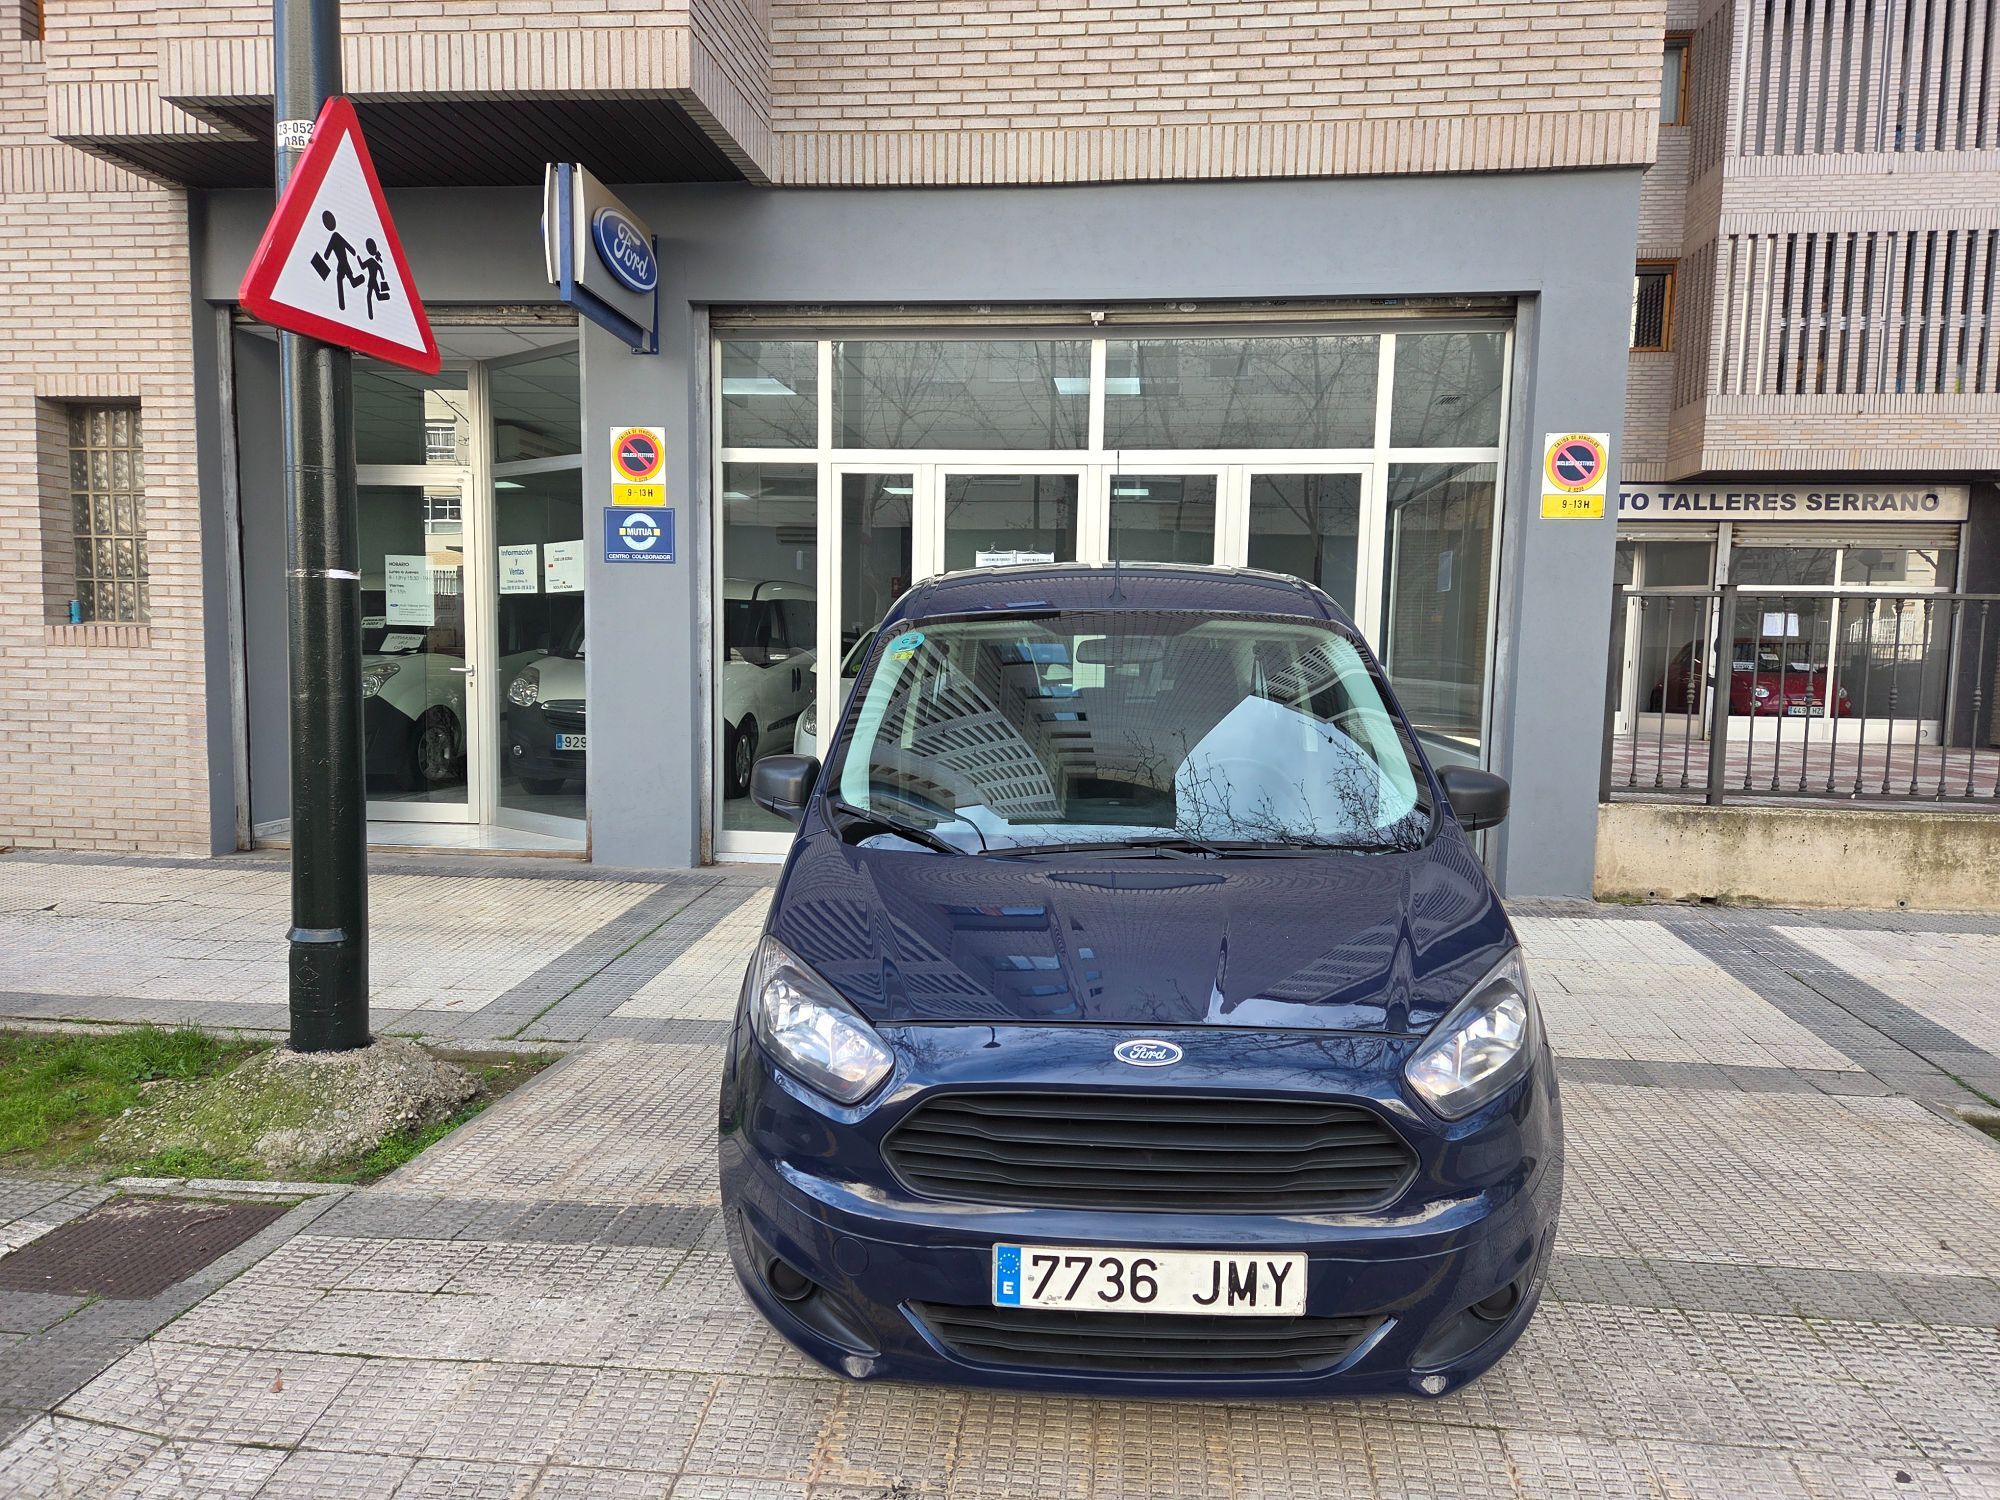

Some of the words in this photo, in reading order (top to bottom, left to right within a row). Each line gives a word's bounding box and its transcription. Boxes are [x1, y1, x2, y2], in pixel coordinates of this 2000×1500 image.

[614, 223, 649, 280] Ford
[1618, 493, 1649, 511] TO
[1658, 493, 1797, 511] TALLERES
[1805, 493, 1940, 512] SERRANO
[626, 527, 653, 536] MUTUA
[500, 548, 533, 557] Información
[509, 567, 525, 576] Ventas
[1129, 1044, 1167, 1060] Ford
[1003, 1281, 1014, 1295] E
[1032, 1254, 1158, 1304] 7736
[1192, 1260, 1293, 1307] JMY
